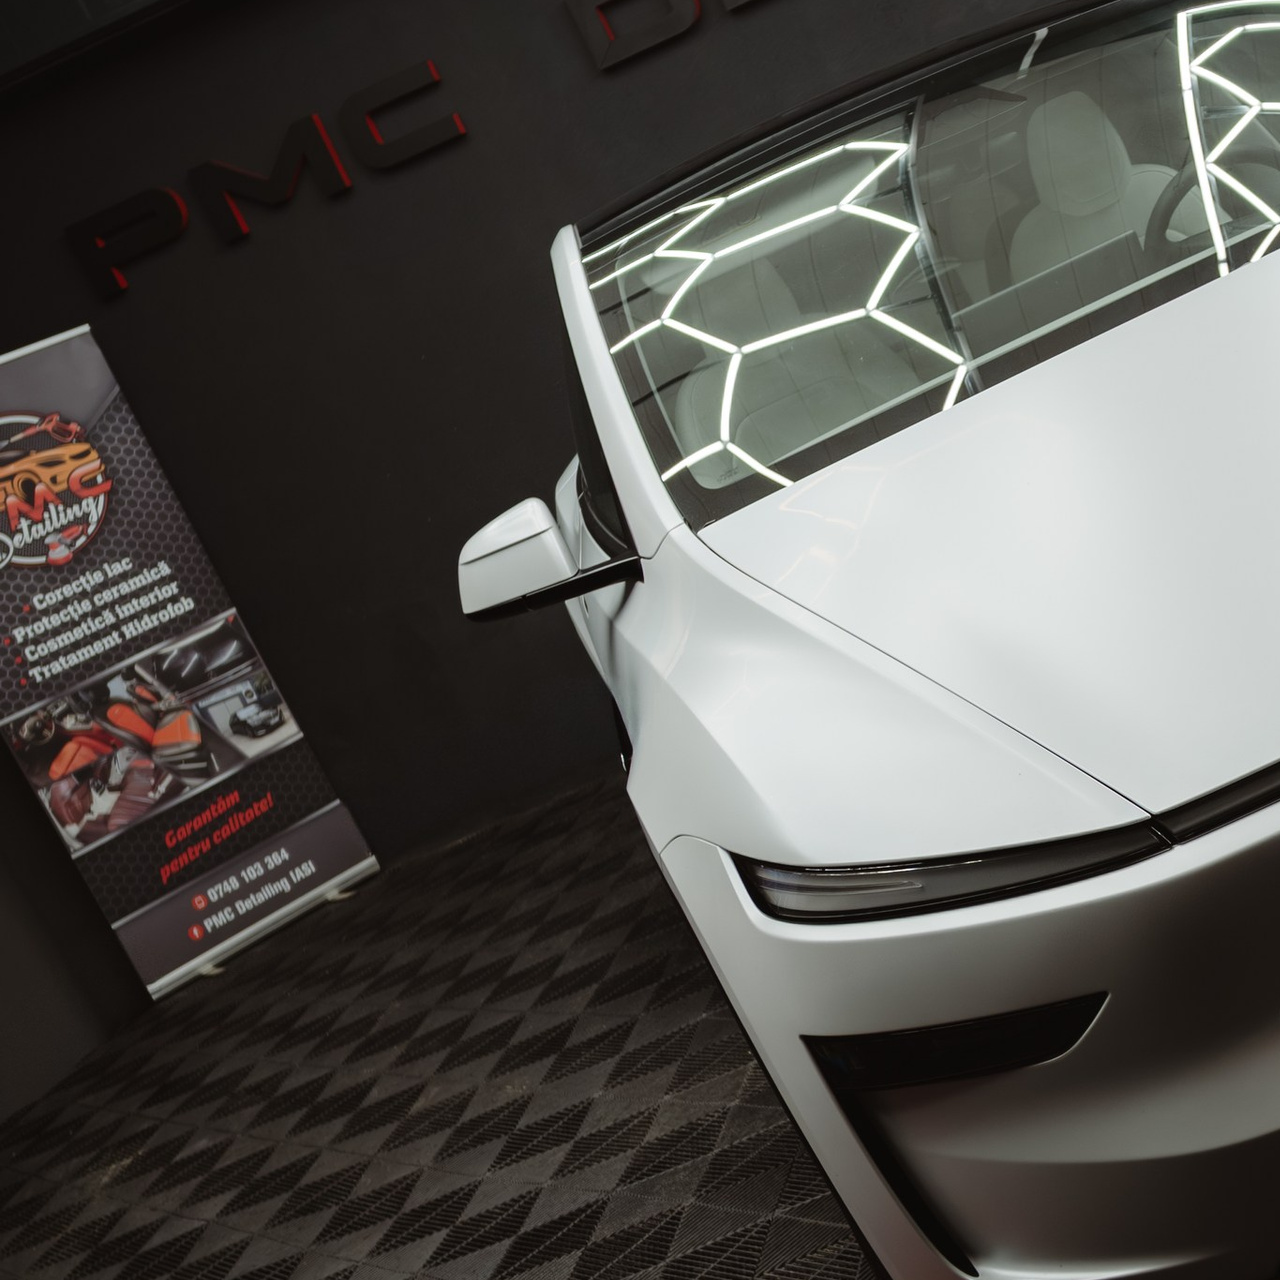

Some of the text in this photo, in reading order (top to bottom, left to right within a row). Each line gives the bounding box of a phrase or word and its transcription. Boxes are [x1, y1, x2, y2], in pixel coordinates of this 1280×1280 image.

[65, 59, 468, 299] PMC
[4, 458, 113, 532] MC
[103, 556, 133, 580] lac
[115, 580, 180, 620] interior
[28, 595, 195, 685] Tratament Hidrofob
[159, 791, 275, 886] pentru calitate!
[203, 859, 316, 934] PMC Detailing IASI
[206, 875, 240, 903] 0748
[240, 862, 264, 884] 103
